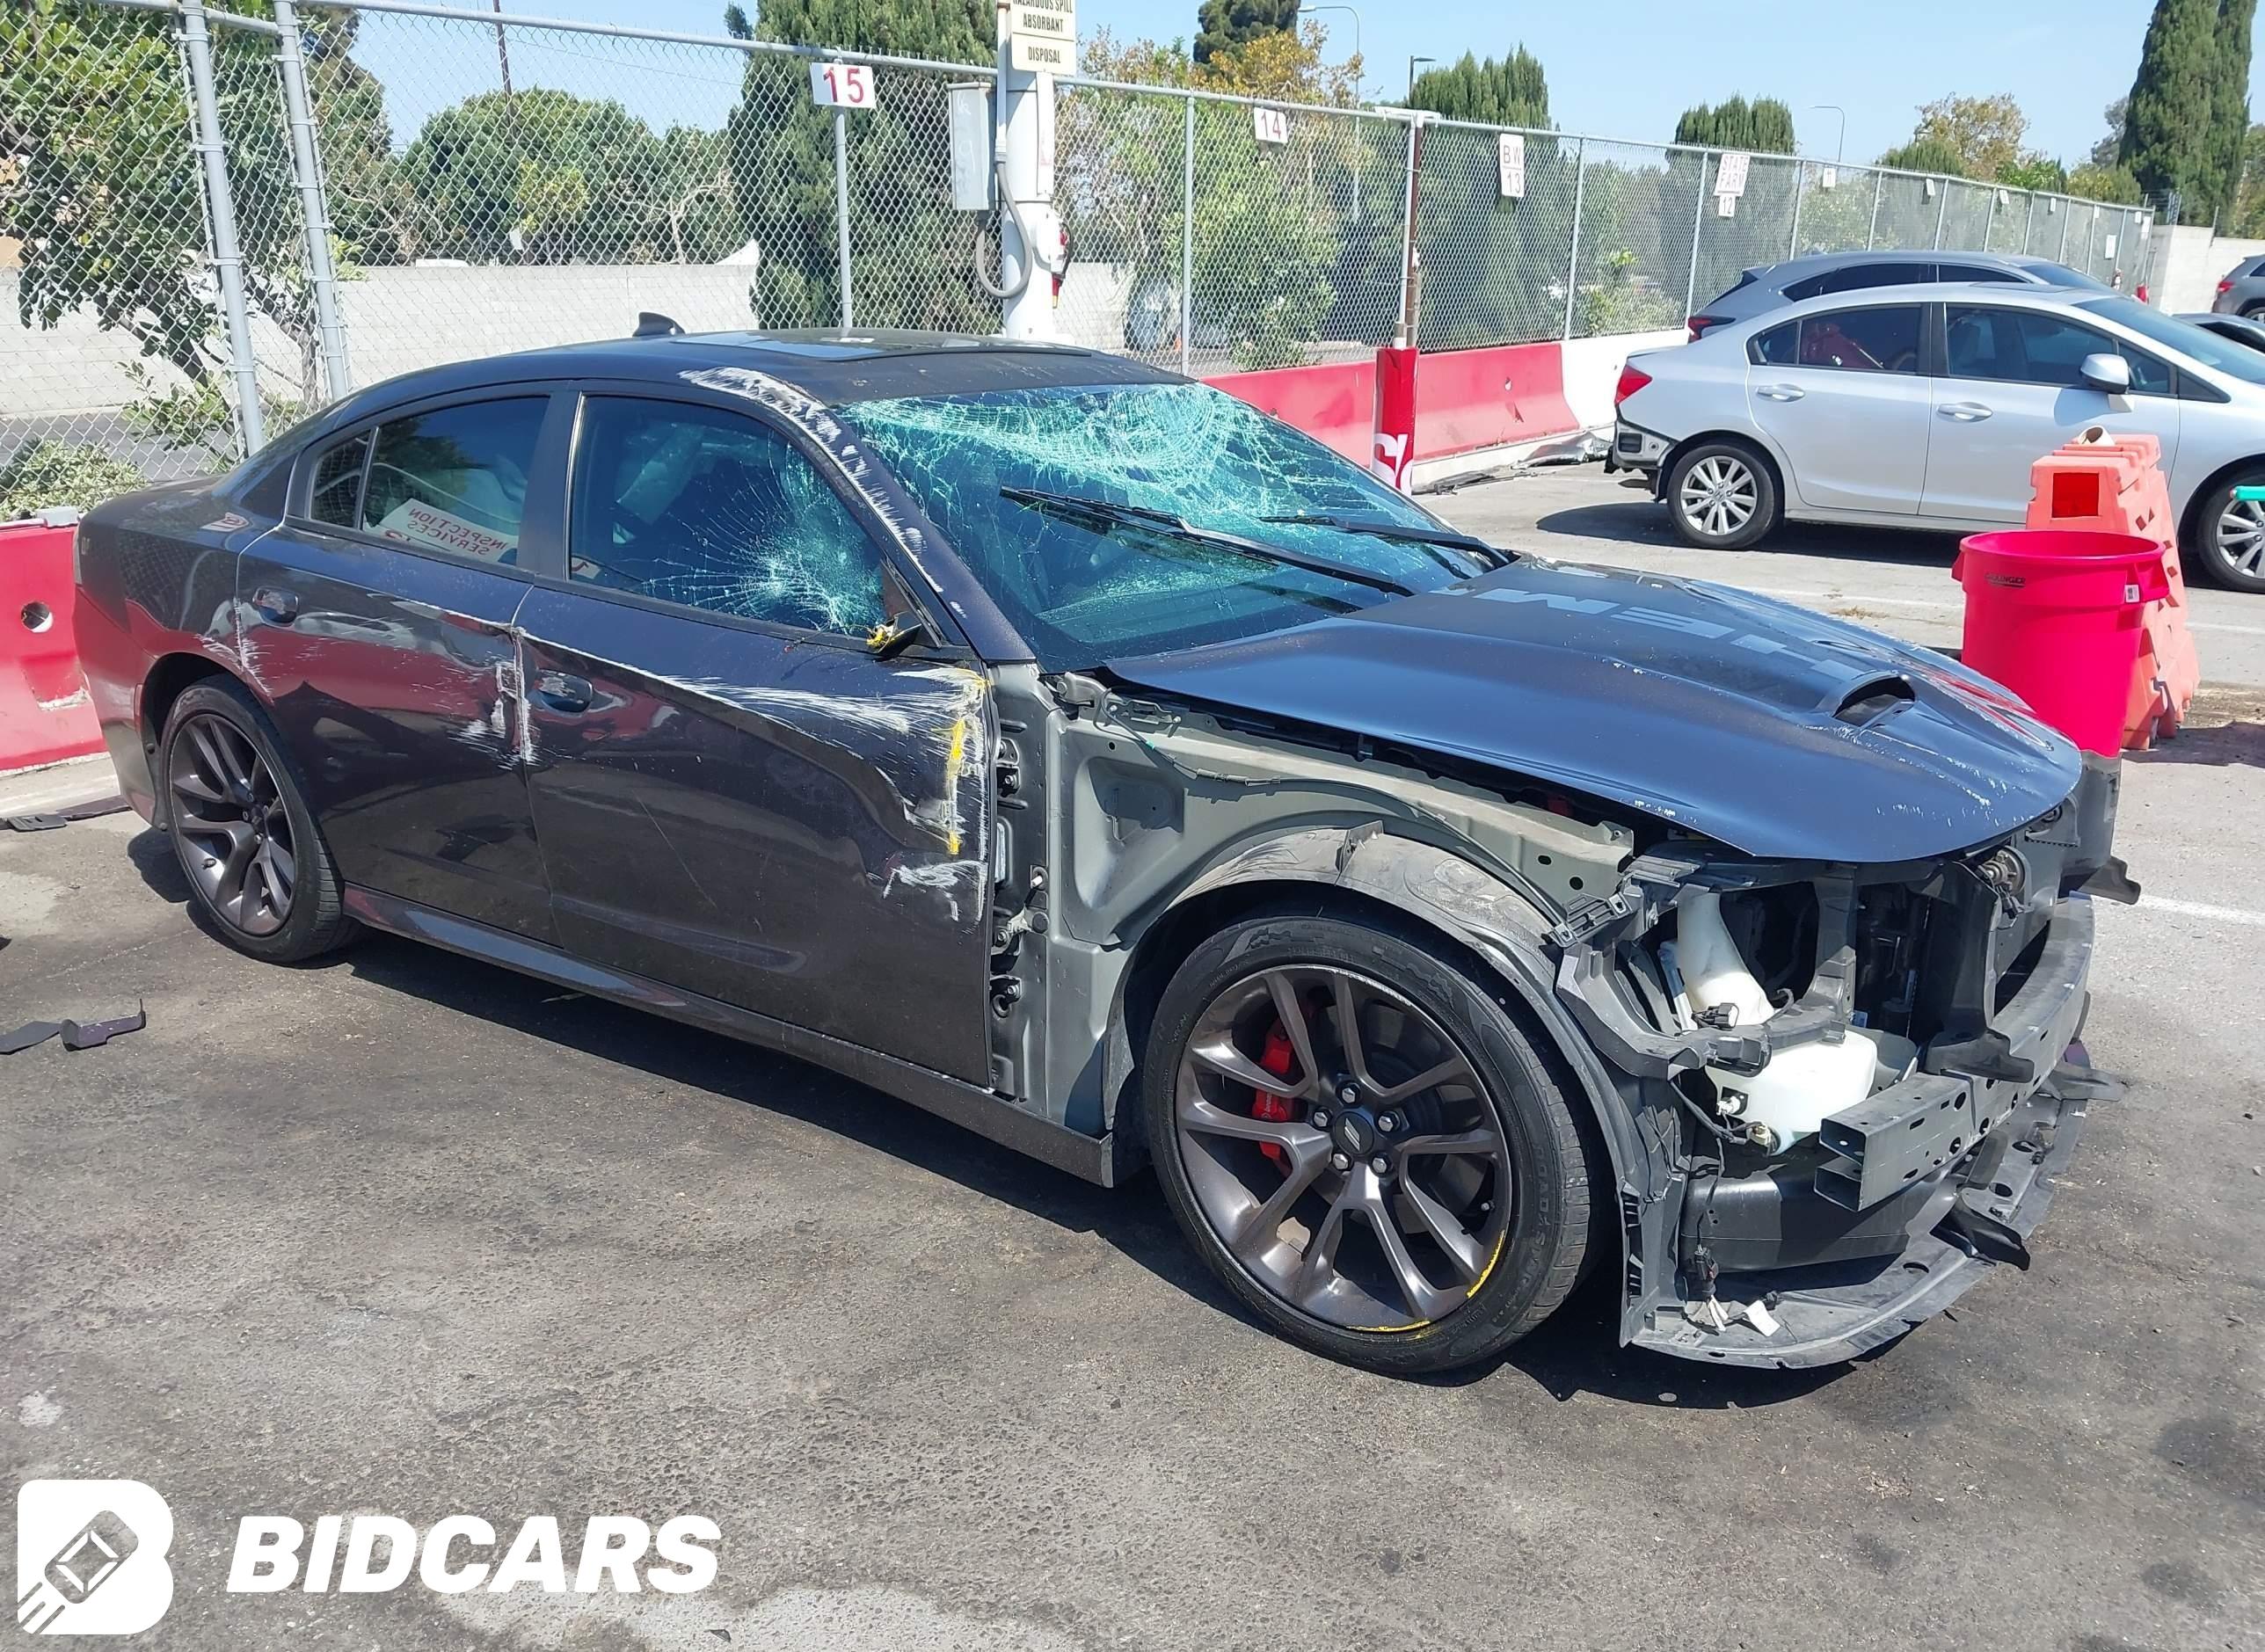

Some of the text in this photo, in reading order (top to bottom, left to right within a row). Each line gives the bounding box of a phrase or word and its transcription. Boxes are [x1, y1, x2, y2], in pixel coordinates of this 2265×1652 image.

[1055, 0, 1073, 13] SPILL
[1023, 13, 1064, 33] ABSORBANT
[1028, 46, 1061, 64] DISPOSAL
[823, 67, 864, 103] 15
[1261, 111, 1282, 141] 14
[1503, 144, 1521, 165] BW
[1507, 171, 1521, 194] 13
[1722, 196, 1733, 215] 12
